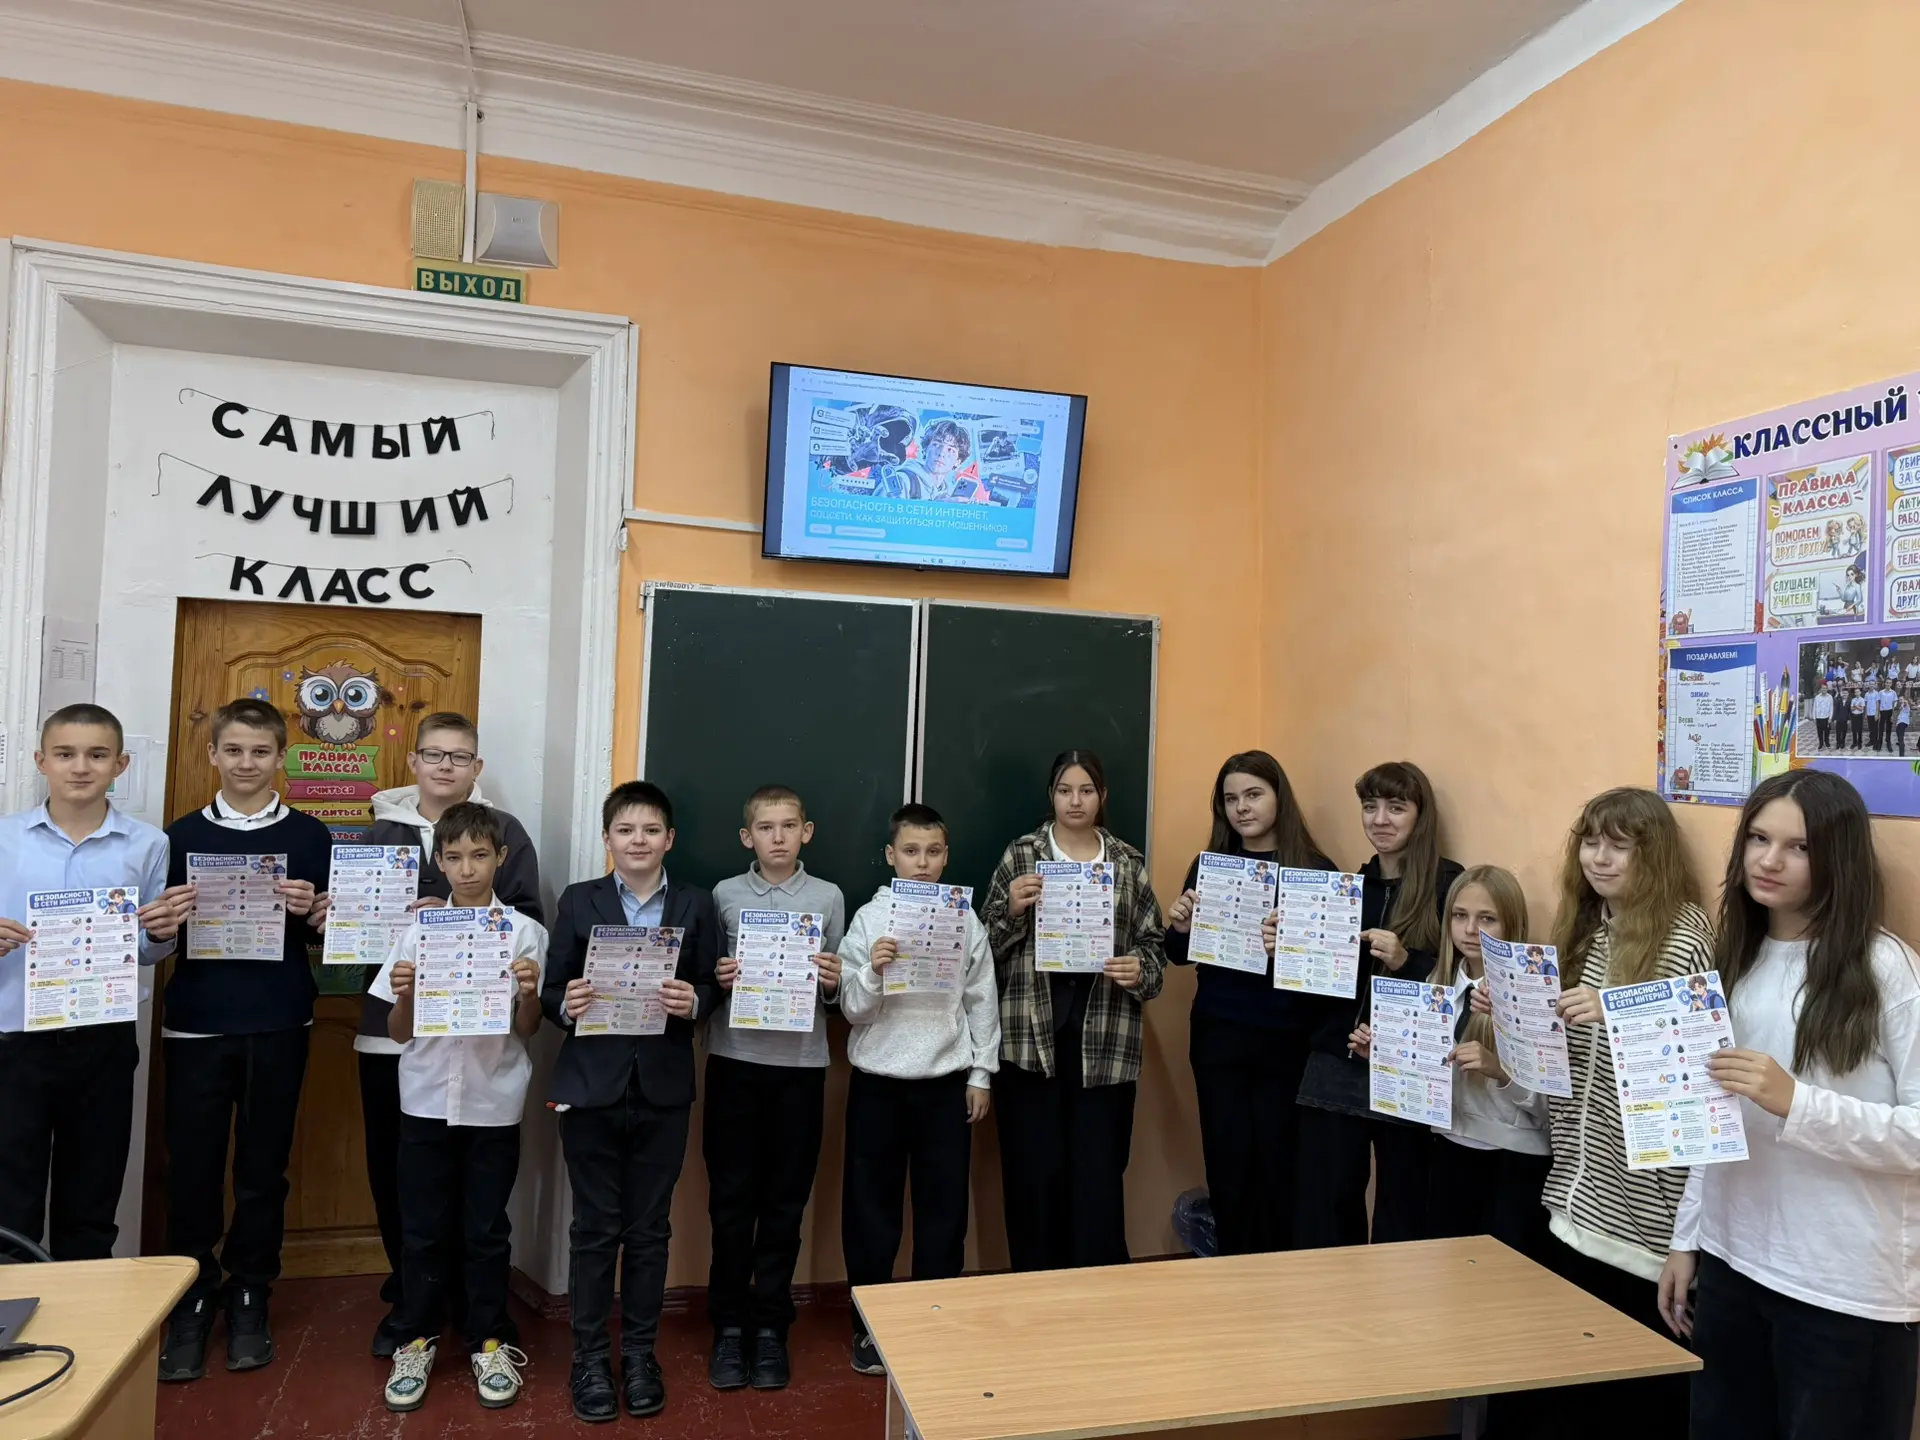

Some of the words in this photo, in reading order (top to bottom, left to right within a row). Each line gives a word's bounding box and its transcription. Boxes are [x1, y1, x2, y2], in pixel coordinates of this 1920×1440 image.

[420, 270, 516, 300] ВЫХОД
[1733, 385, 1907, 459] КЛАССНЫЙ
[211, 401, 461, 460] САМЫЙ
[1778, 471, 1856, 497] ПРАВИЛА
[1899, 471, 1911, 484] ЗА
[1682, 493, 1712, 504] СПИСОК
[1713, 486, 1743, 498] КЛАССА
[1783, 491, 1850, 514] КЛАССА
[196, 474, 489, 535] ЛУЧШИЙ
[811, 497, 894, 513] БЕЗОПАСНОСТЬ
[896, 504, 903, 513] В
[906, 505, 932, 516] СЕТИ
[856, 514, 873, 522] КАК
[876, 515, 933, 527] ЗАЩИТИТЬСЯ
[935, 520, 945, 528] ОТ
[948, 521, 1008, 533] МОШЕННИКОВ
[1898, 511, 1920, 525] РАБО
[1775, 527, 1819, 543] ПОМОГАЕМ
[1774, 545, 1794, 559] ДРУГ
[1897, 553, 1920, 566] ТЕЛЕ
[229, 555, 435, 604] КЛАСС
[1773, 576, 1816, 592] СЛУШАЕМ
[1772, 593, 1811, 608] УЧИТЕЛЯ
[1686, 650, 1738, 661] ПОЗДРАВЛЯЕМ!
[299, 751, 368, 763] ПРАВИЛА
[302, 763, 361, 774] КЛАССА
[307, 786, 355, 795] УЧИТЬСЯ
[34, 891, 91, 902] БЕЗОПАСНОСТЬ
[423, 909, 473, 917] БЕЗОПАСНОСТЬ
[1376, 980, 1418, 990] БЕЗОПАСНОСТЬ
[1608, 982, 1668, 1001] БЕЗОПАСНОСТЬ
[1609, 1001, 1615, 1010] В
[1616, 997, 1635, 1008] СЕТИ
[1635, 990, 1670, 1003] ИНТЕРНЕТ
